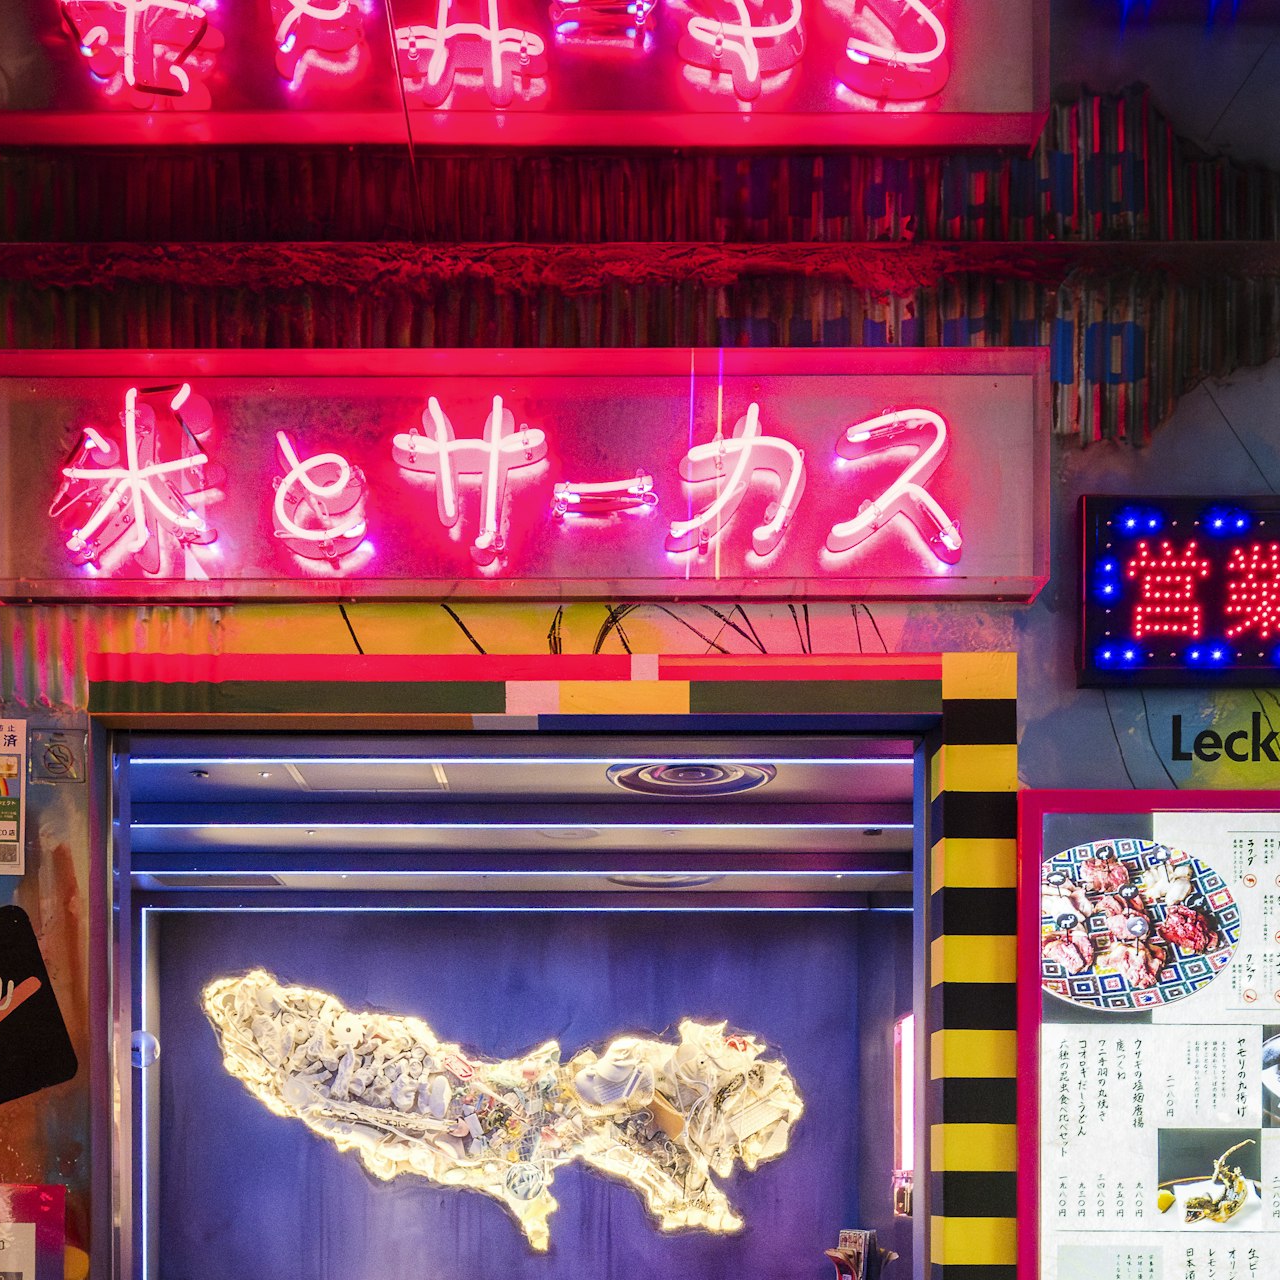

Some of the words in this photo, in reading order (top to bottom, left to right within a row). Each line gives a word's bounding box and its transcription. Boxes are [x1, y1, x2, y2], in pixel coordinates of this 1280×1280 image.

[47, 383, 964, 573] 米とサーカス
[1247, 839, 1257, 866] ラクダ
[1245, 953, 1256, 982] クジャク
[1077, 1039, 1088, 1137] コオロギだしうどん
[1097, 1039, 1109, 1122] ワニ手羽の丸焼き
[1236, 1038, 1248, 1117] ヤモリの丸揚げ
